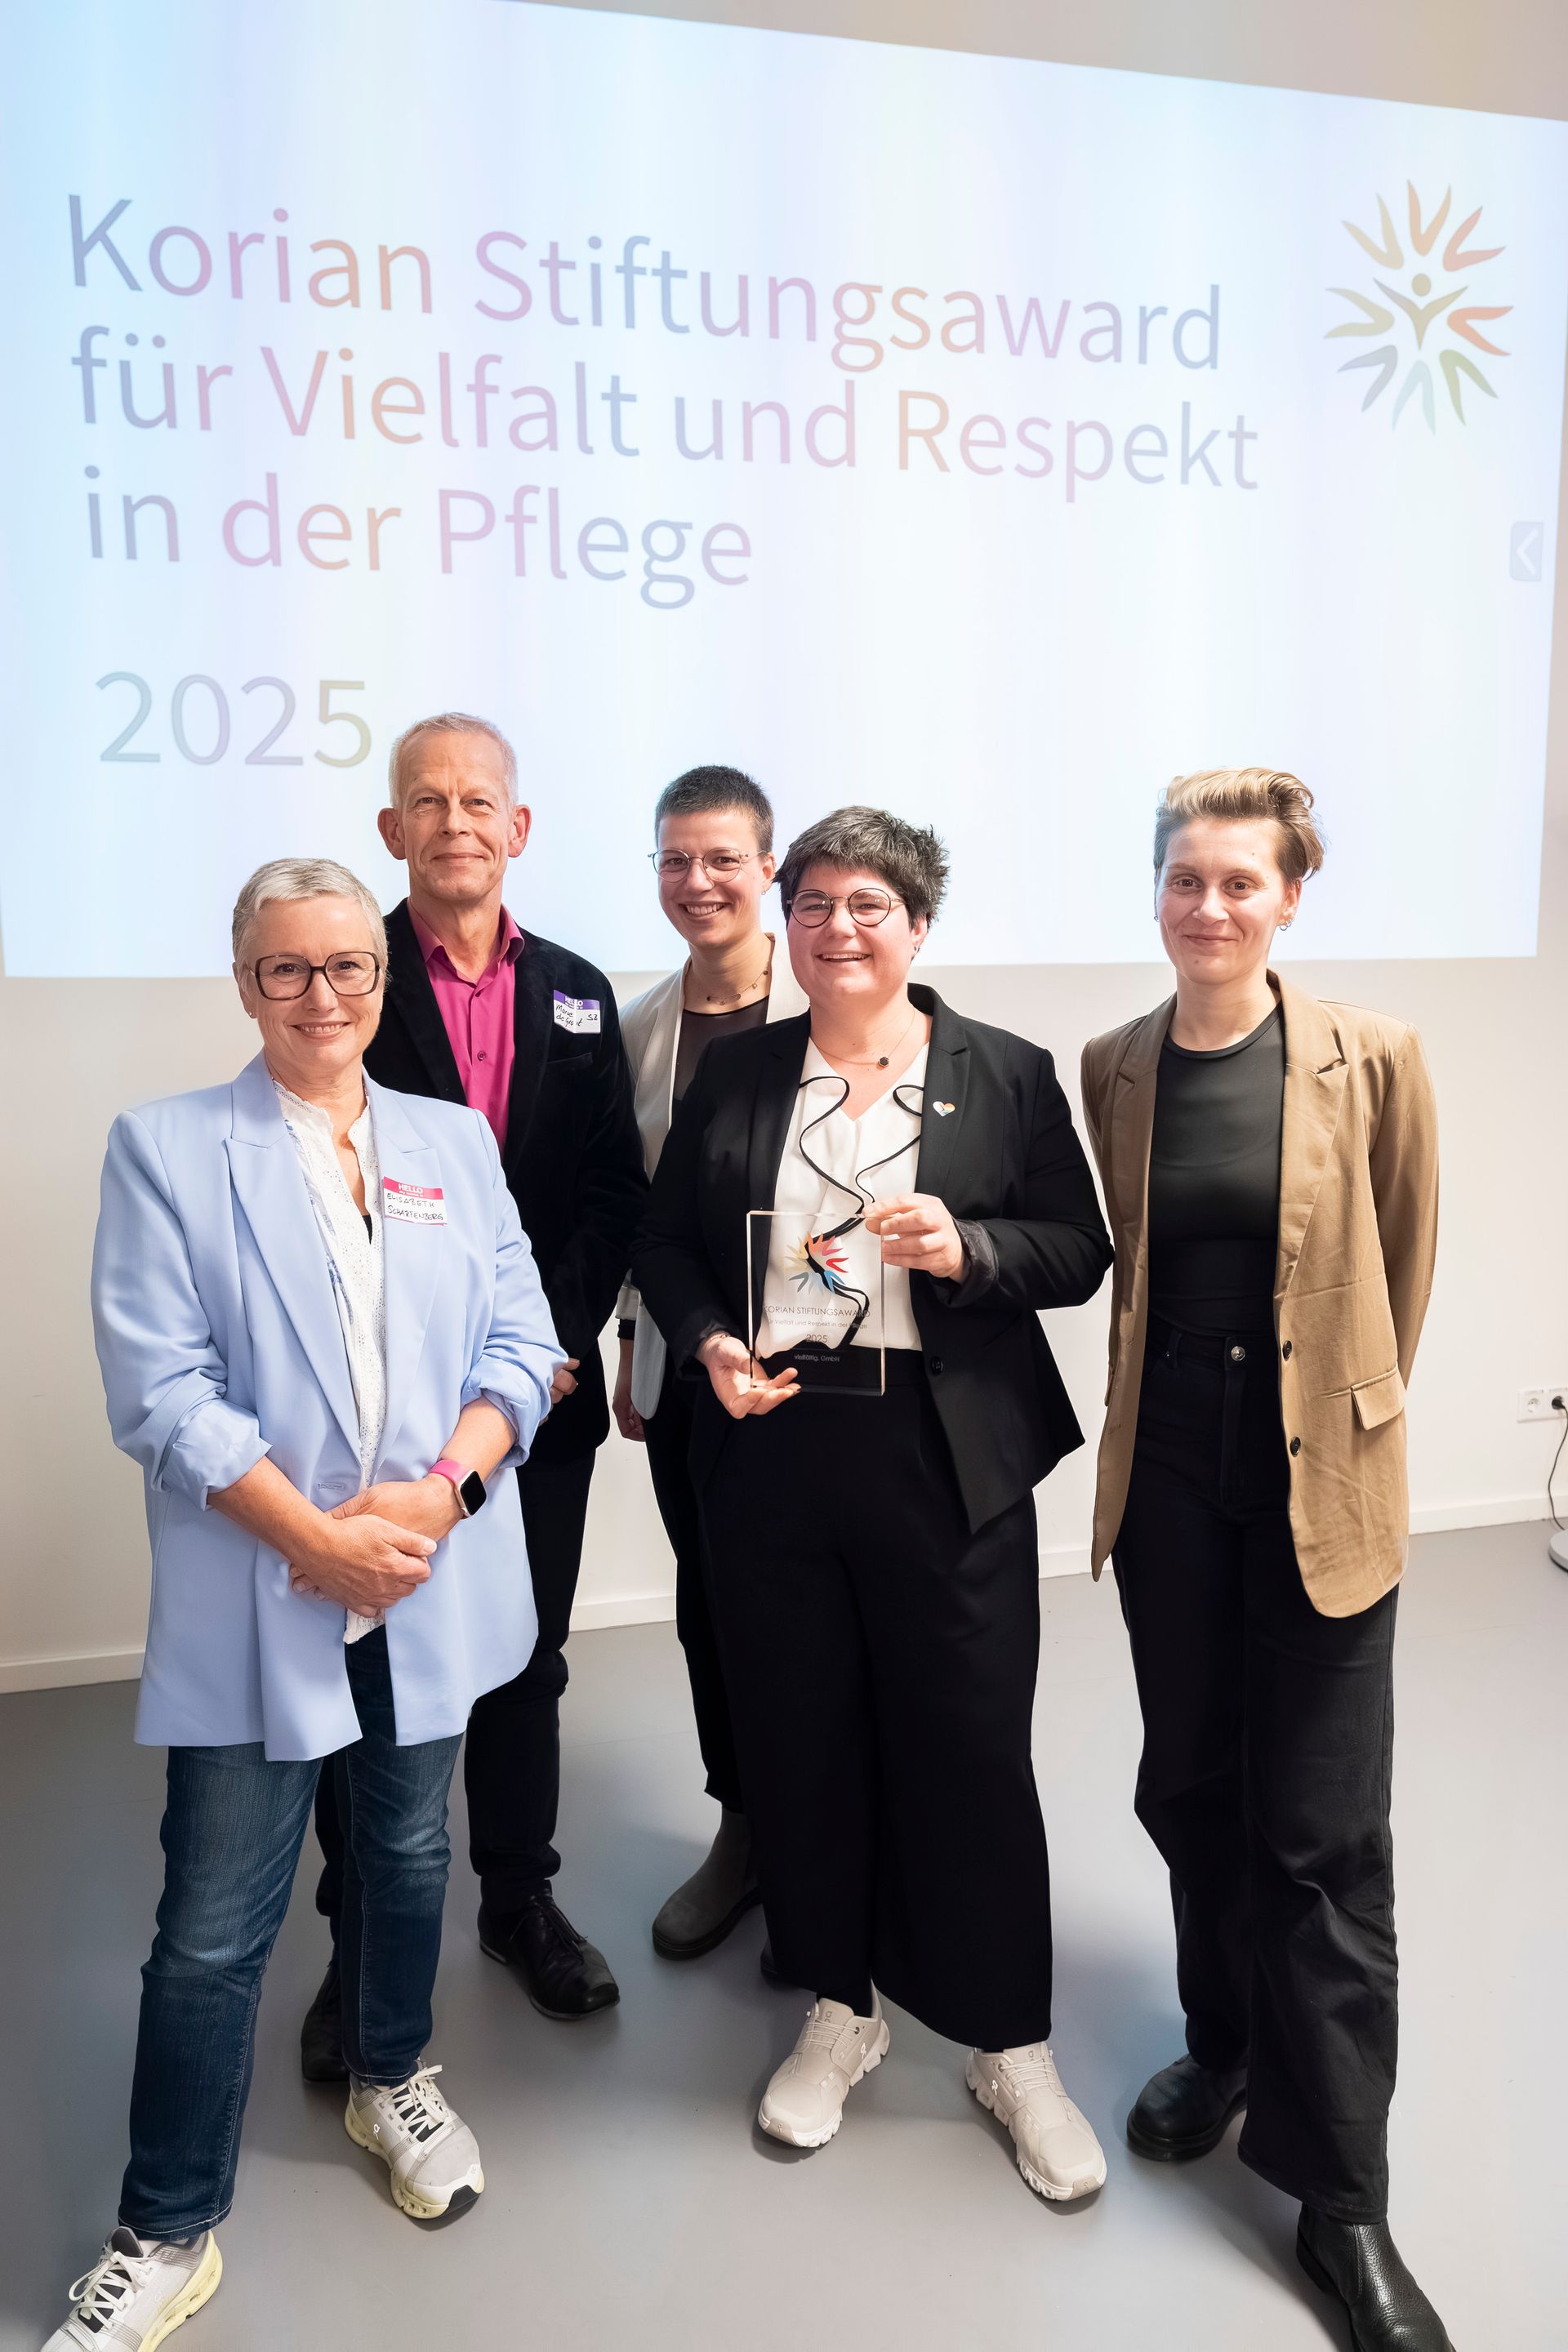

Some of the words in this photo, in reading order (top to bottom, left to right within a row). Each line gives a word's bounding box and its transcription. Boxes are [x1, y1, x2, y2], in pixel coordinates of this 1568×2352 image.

[68, 194, 434, 315] Korian
[474, 229, 1220, 373] Stiftungsaward
[71, 325, 234, 432] für
[260, 345, 640, 457] Vielfalt
[673, 380, 857, 468] und
[898, 390, 1258, 503] Respekt
[84, 465, 180, 563] in
[222, 472, 402, 572] der
[438, 483, 753, 610] Pflege
[95, 671, 372, 768] 2025
[398, 1183, 423, 1194] HELLO
[797, 1307, 871, 1317] STIFTUNGSAWARD
[806, 1334, 828, 1343] 2025
